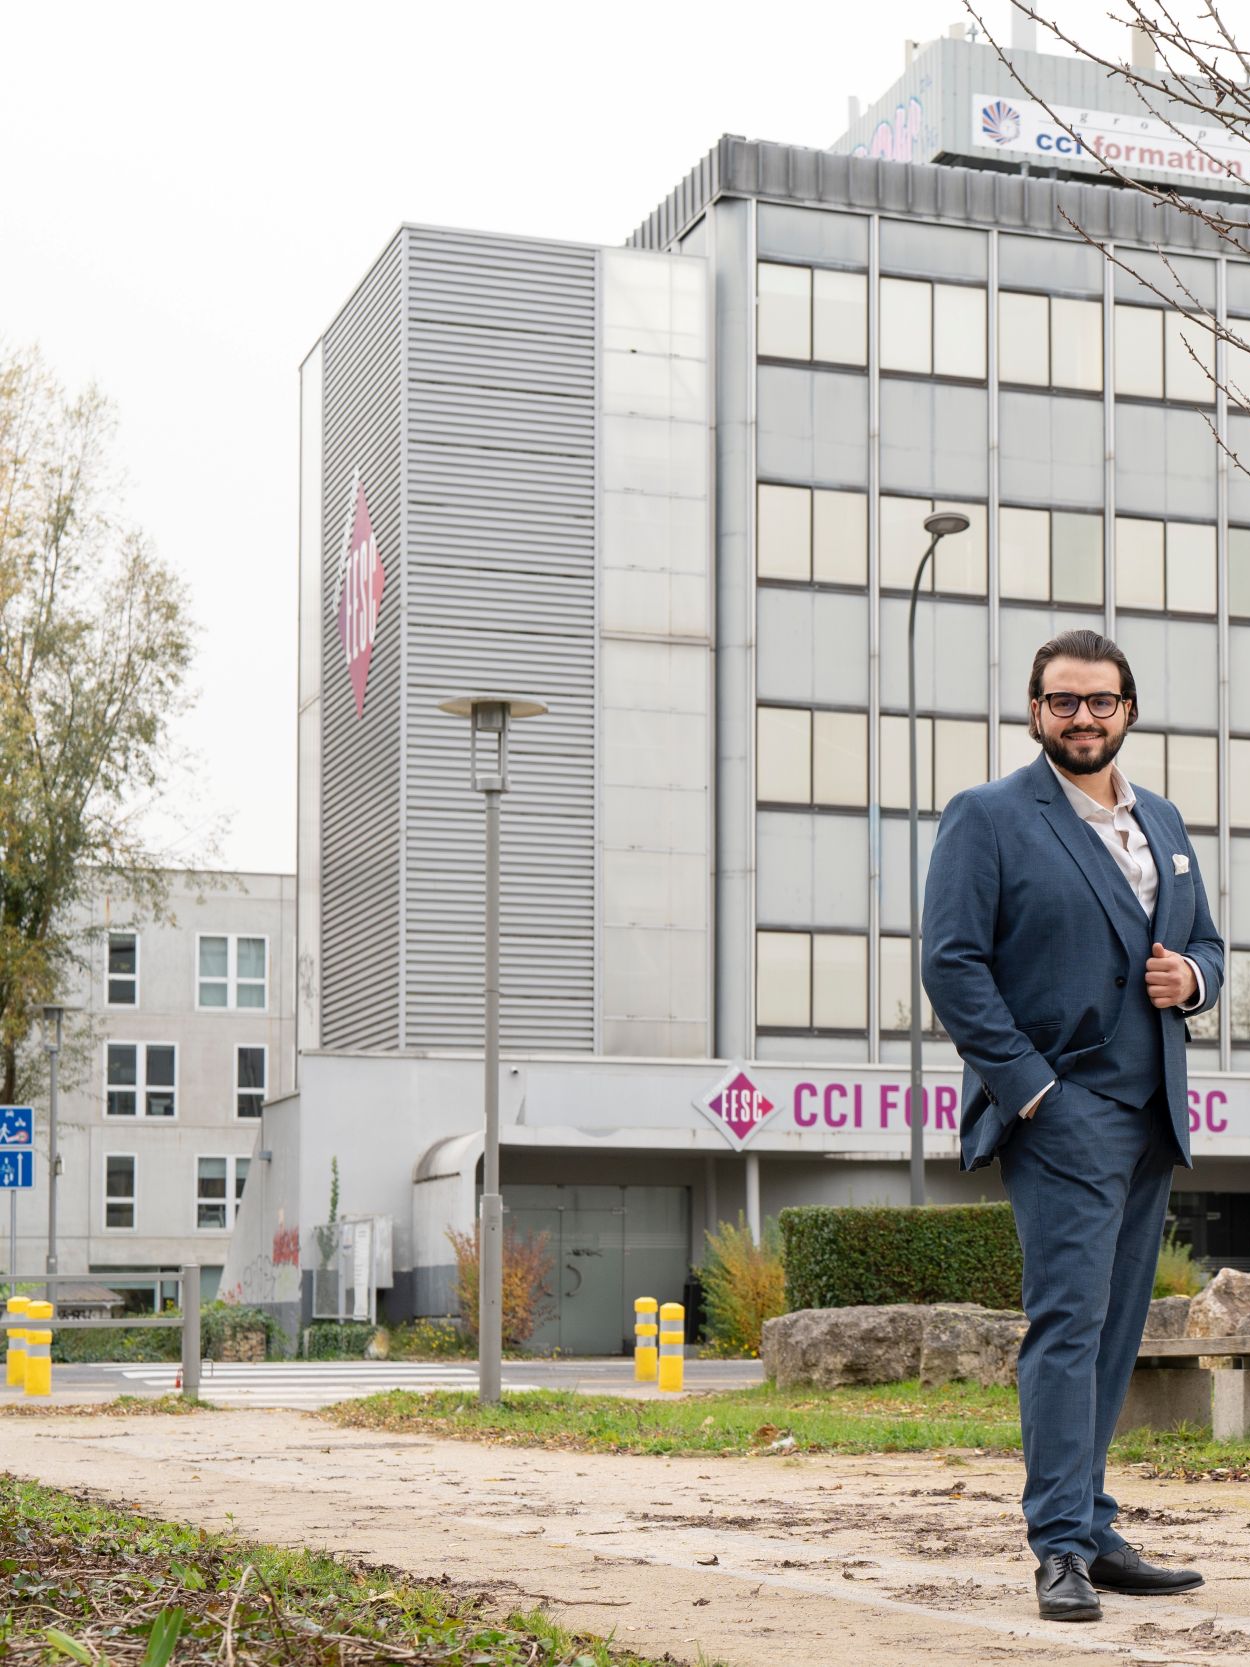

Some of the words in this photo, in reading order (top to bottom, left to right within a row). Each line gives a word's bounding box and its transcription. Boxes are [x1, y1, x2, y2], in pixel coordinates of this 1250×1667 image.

[1079, 112, 1234, 143] grope
[1036, 132, 1082, 155] cci
[1095, 135, 1242, 177] formation
[346, 532, 376, 665] EESC
[722, 1089, 762, 1122] EESC
[794, 1083, 862, 1128] CCI
[880, 1085, 958, 1130] FOR
[1187, 1090, 1228, 1133] SC
